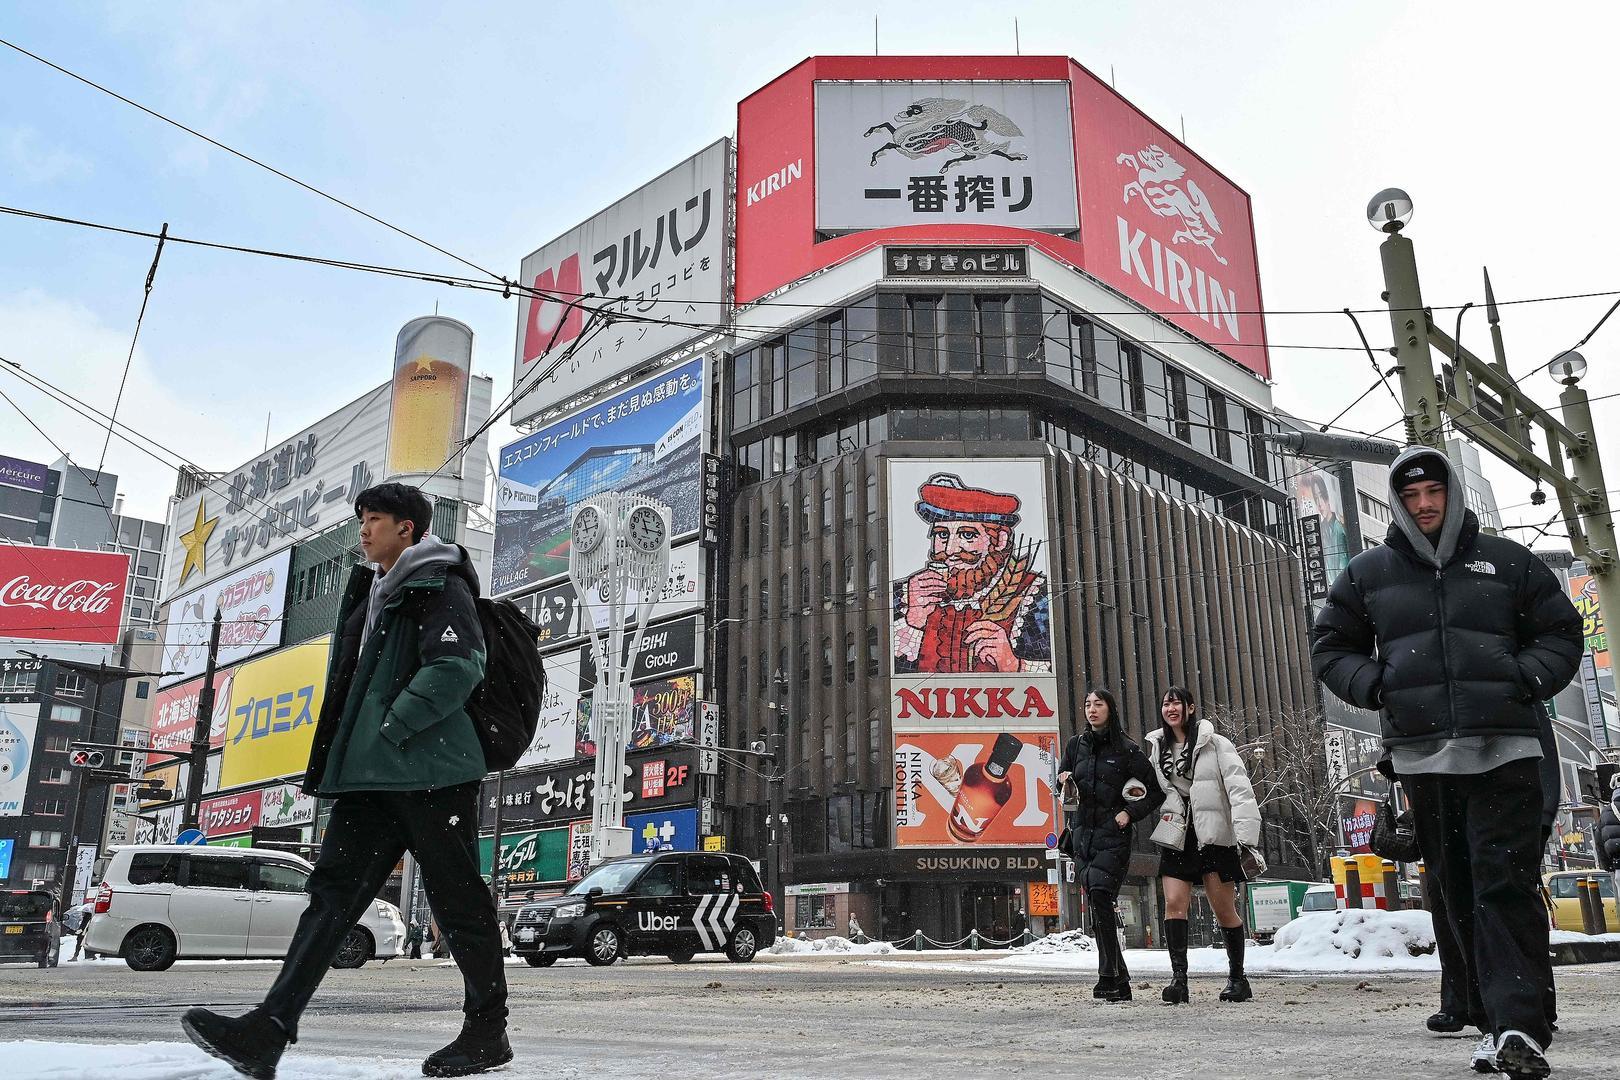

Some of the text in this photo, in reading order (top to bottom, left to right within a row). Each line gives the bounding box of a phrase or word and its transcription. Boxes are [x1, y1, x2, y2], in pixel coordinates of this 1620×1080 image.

[747, 158, 803, 208] KIRIN
[864, 174, 1034, 214] 一番搾り
[592, 188, 711, 296] マルハン
[892, 252, 1022, 272] すすきのビル
[1116, 215, 1241, 342] KIRIN
[410, 374, 437, 382] SAPPORO
[225, 433, 318, 516] 北海道は
[221, 459, 374, 567] サッポロビール
[514, 491, 537, 504] FIGHTERS
[0, 574, 120, 614] Coca-Cola
[223, 571, 267, 612] カラオケ
[499, 567, 529, 586] VILLAGE
[645, 650, 678, 669] Group
[233, 684, 315, 746] プロミス
[895, 685, 1055, 720] NIKKA
[666, 765, 688, 787] 2F
[895, 752, 908, 827] FRONTIER
[910, 752, 922, 801] NIKKA
[210, 804, 252, 829] ワタショウ
[916, 857, 1043, 870] SUSUKINO BLD.
[637, 911, 680, 931] Uber
